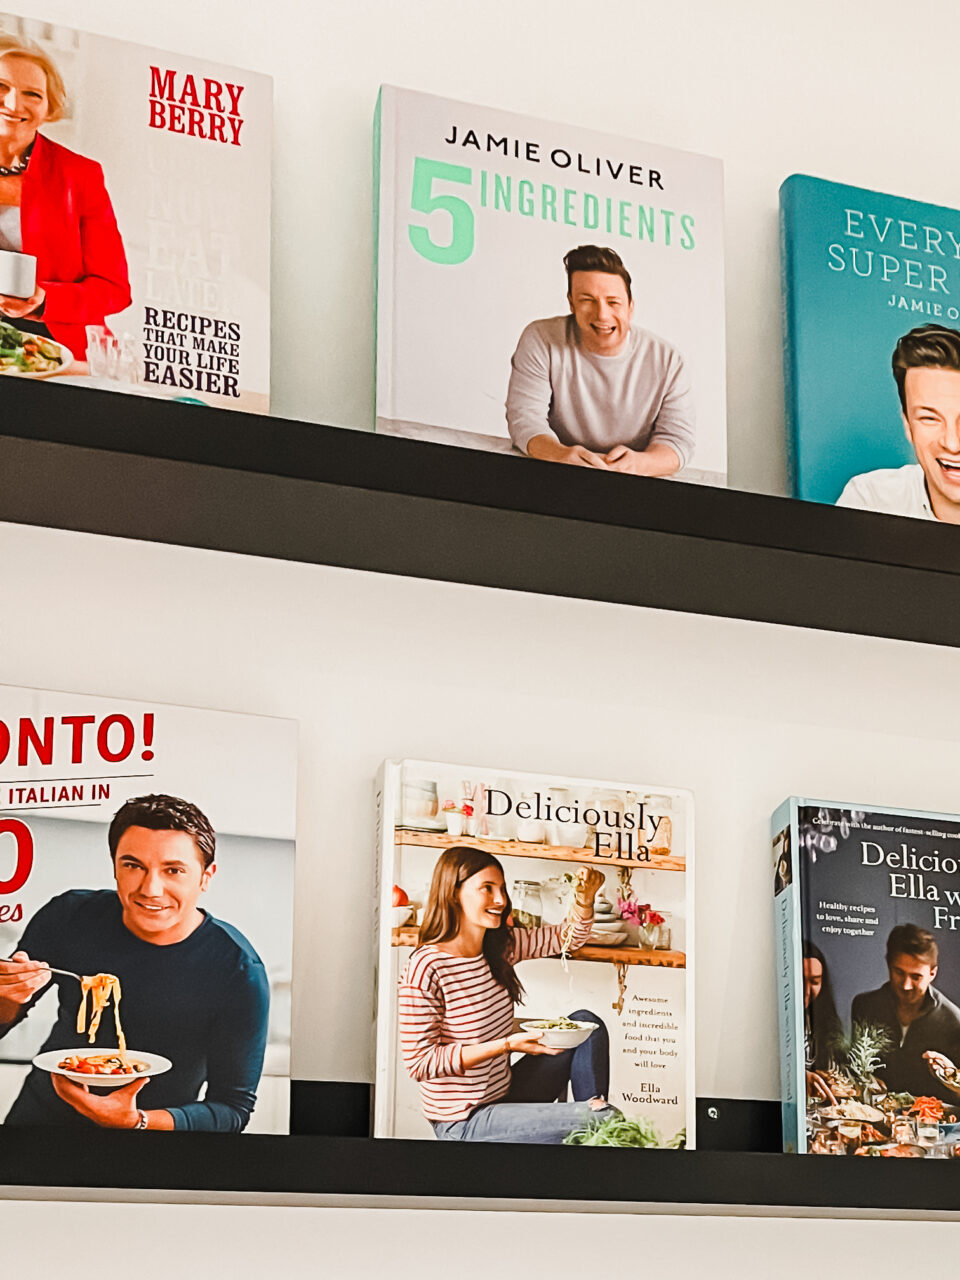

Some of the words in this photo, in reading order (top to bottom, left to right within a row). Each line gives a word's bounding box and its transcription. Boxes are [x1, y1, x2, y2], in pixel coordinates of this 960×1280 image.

[149, 65, 244, 117] MARY
[149, 99, 243, 146] BERRY
[445, 126, 541, 162] JAMIE
[551, 149, 664, 190] OLIVER
[408, 156, 475, 265] 5
[481, 170, 695, 250] INGREDIENTS
[828, 244, 951, 295] SUPER
[888, 295, 942, 317] JAMIE
[145, 307, 240, 341] RECIPES
[144, 328, 187, 347] THAT
[193, 336, 239, 357] MAKE
[143, 343, 191, 366] YOUR
[197, 353, 239, 375] LIFE
[144, 361, 240, 398] EASIER
[9, 785, 83, 804] ITALIAN
[92, 784, 110, 800] IN
[484, 789, 662, 841] Deliciously
[594, 832, 652, 862] Ella
[889, 874, 939, 901] Ella
[819, 901, 848, 912] Healthy
[850, 905, 875, 914] recipes
[822, 926, 842, 935] enjoy
[843, 928, 874, 936] together
[625, 1033, 642, 1041] food
[639, 1022, 678, 1030] incredible
[640, 1049, 656, 1057] your
[660, 1049, 677, 1057] body
[651, 1061, 666, 1069] love
[622, 1093, 678, 1104] Woodward
[641, 1083, 660, 1092] Ella
